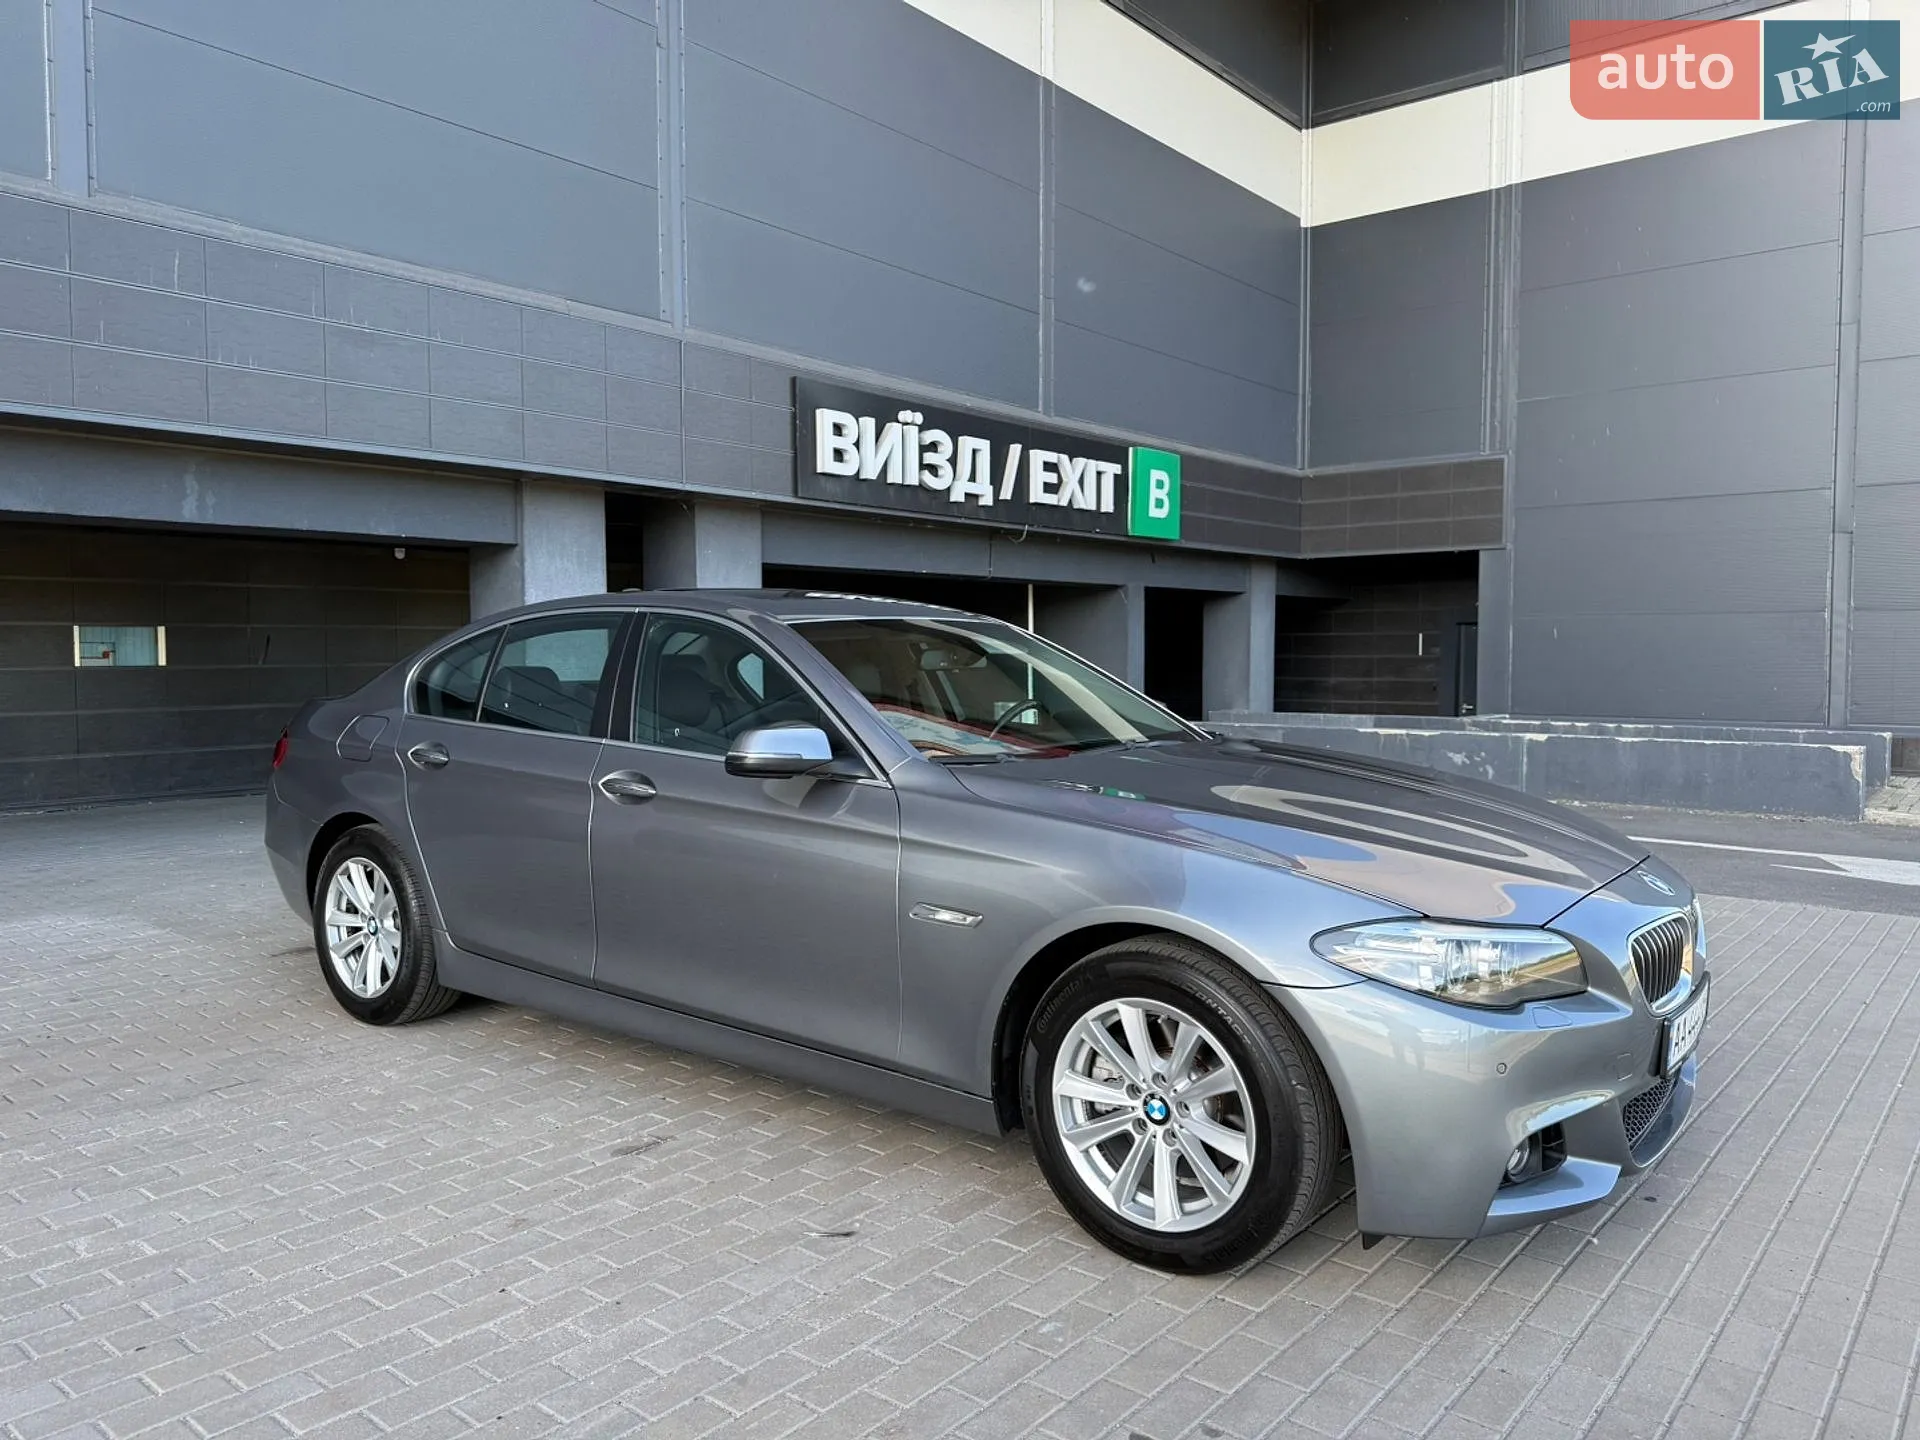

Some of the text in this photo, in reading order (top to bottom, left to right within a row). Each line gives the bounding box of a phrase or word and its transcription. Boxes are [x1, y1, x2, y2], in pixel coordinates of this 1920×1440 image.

[815, 407, 1122, 513] ВИЇЗД / EXIT
